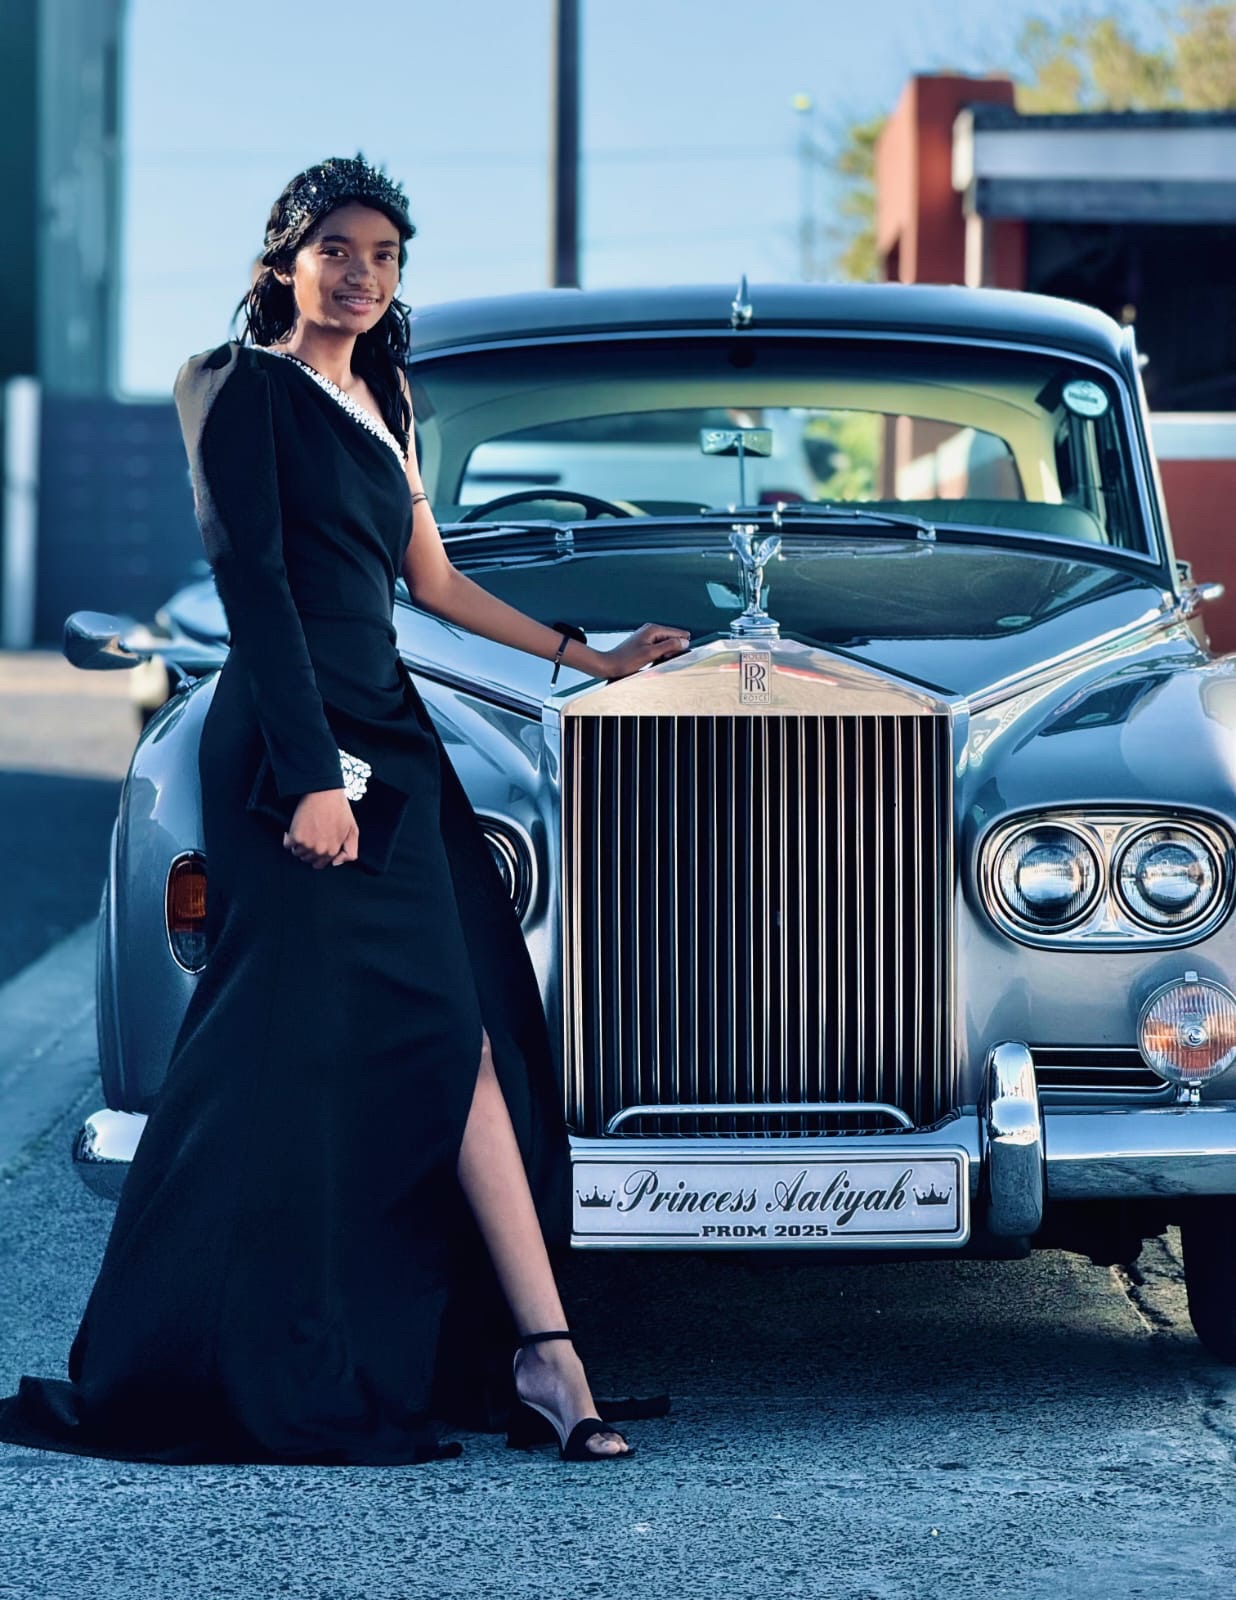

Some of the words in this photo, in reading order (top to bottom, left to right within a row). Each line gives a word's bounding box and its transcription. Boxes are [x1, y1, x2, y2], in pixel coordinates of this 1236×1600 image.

[617, 1169, 757, 1213] Princess
[766, 1169, 913, 1227] Aaliyah
[702, 1225, 767, 1237] PROM
[774, 1225, 829, 1237] 2025
